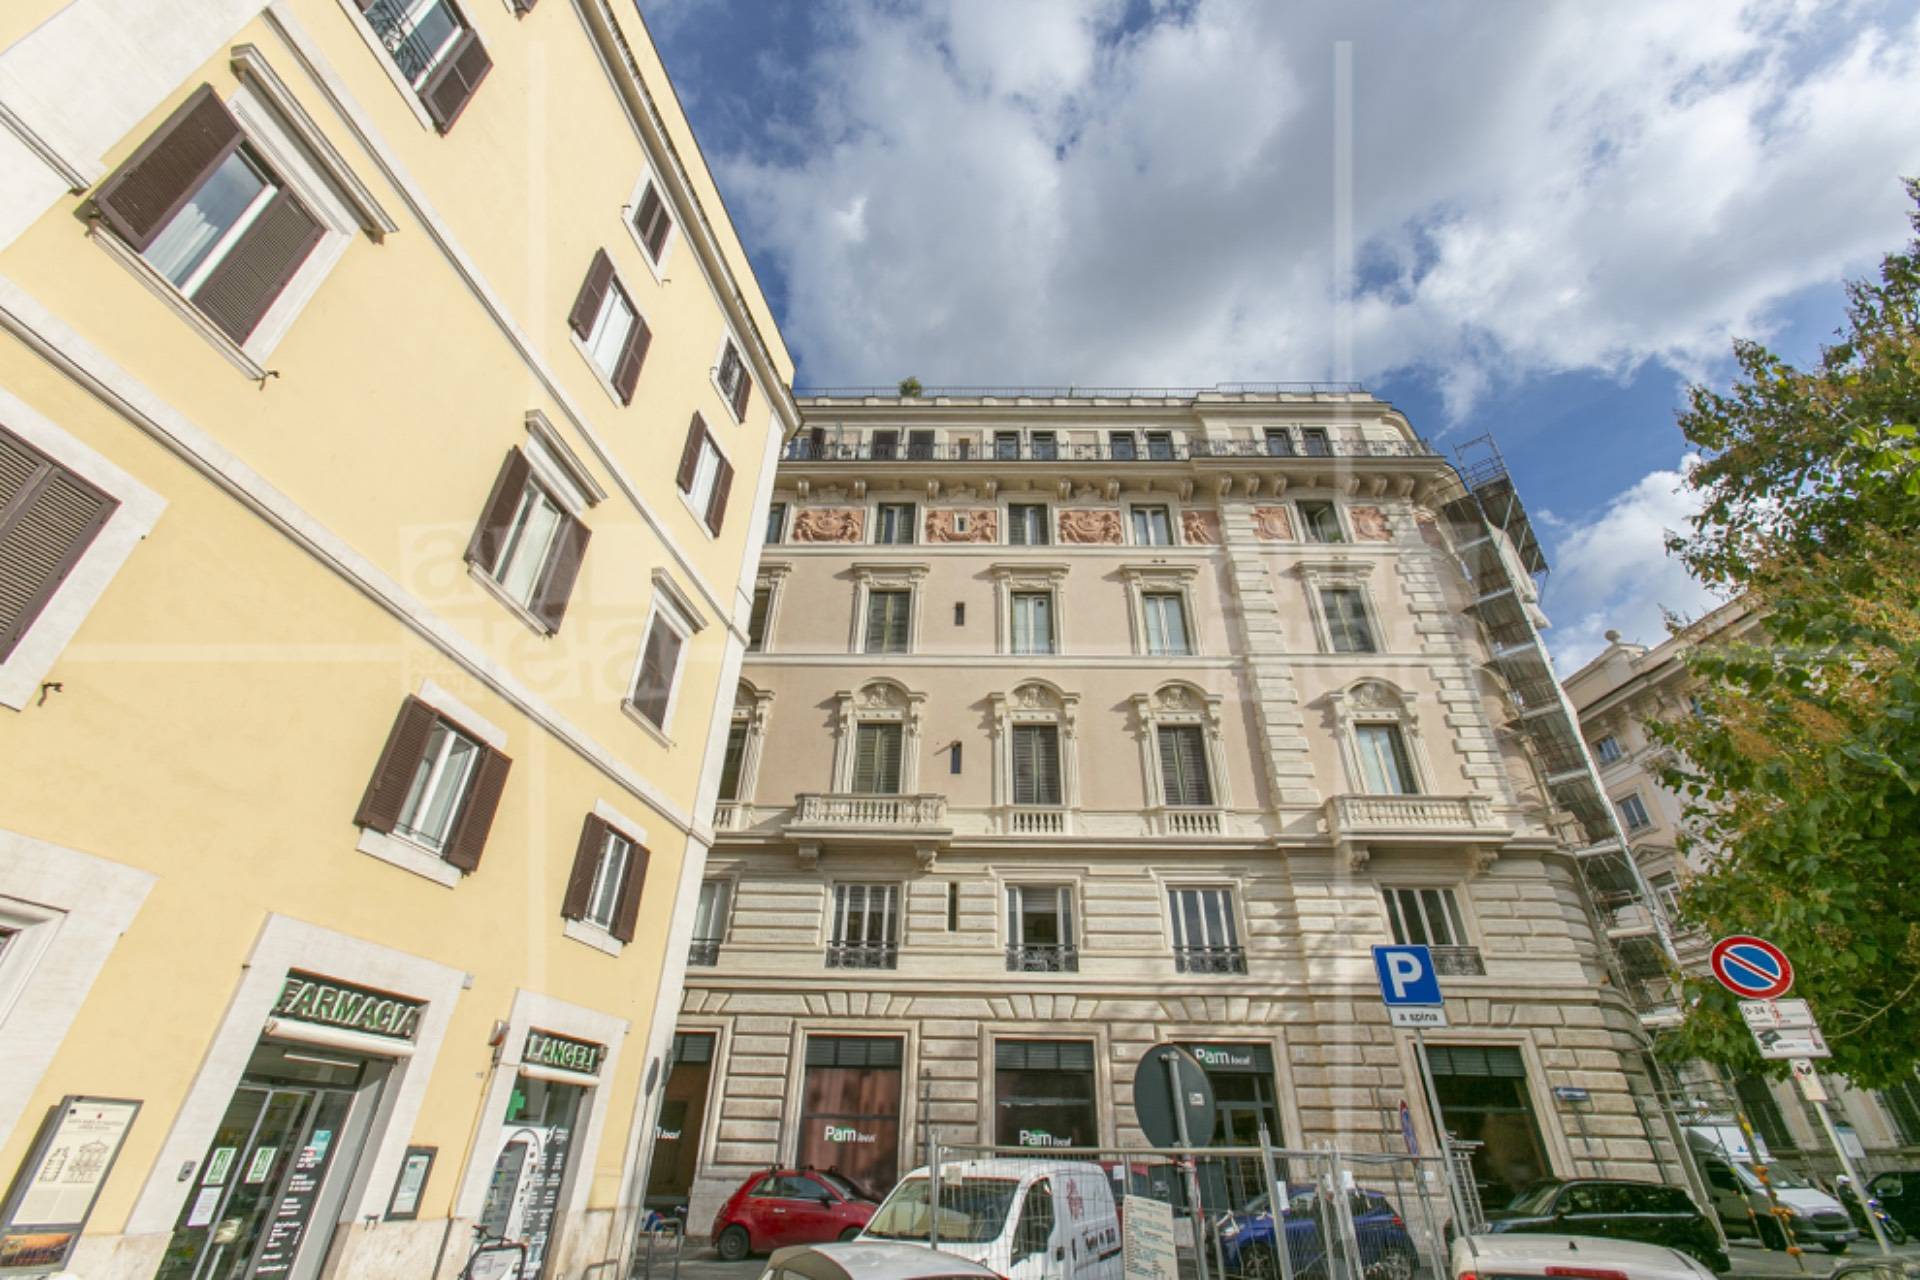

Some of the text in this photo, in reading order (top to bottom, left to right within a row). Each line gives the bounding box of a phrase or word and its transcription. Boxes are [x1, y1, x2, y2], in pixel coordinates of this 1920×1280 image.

[1385, 952, 1422, 998] P
[276, 979, 419, 1036] FARMACIA
[1399, 1012, 1438, 1022] a spina
[1195, 1048, 1230, 1065] Pam
[824, 1125, 856, 1142] Pam
[1019, 1129, 1052, 1146] Pam
